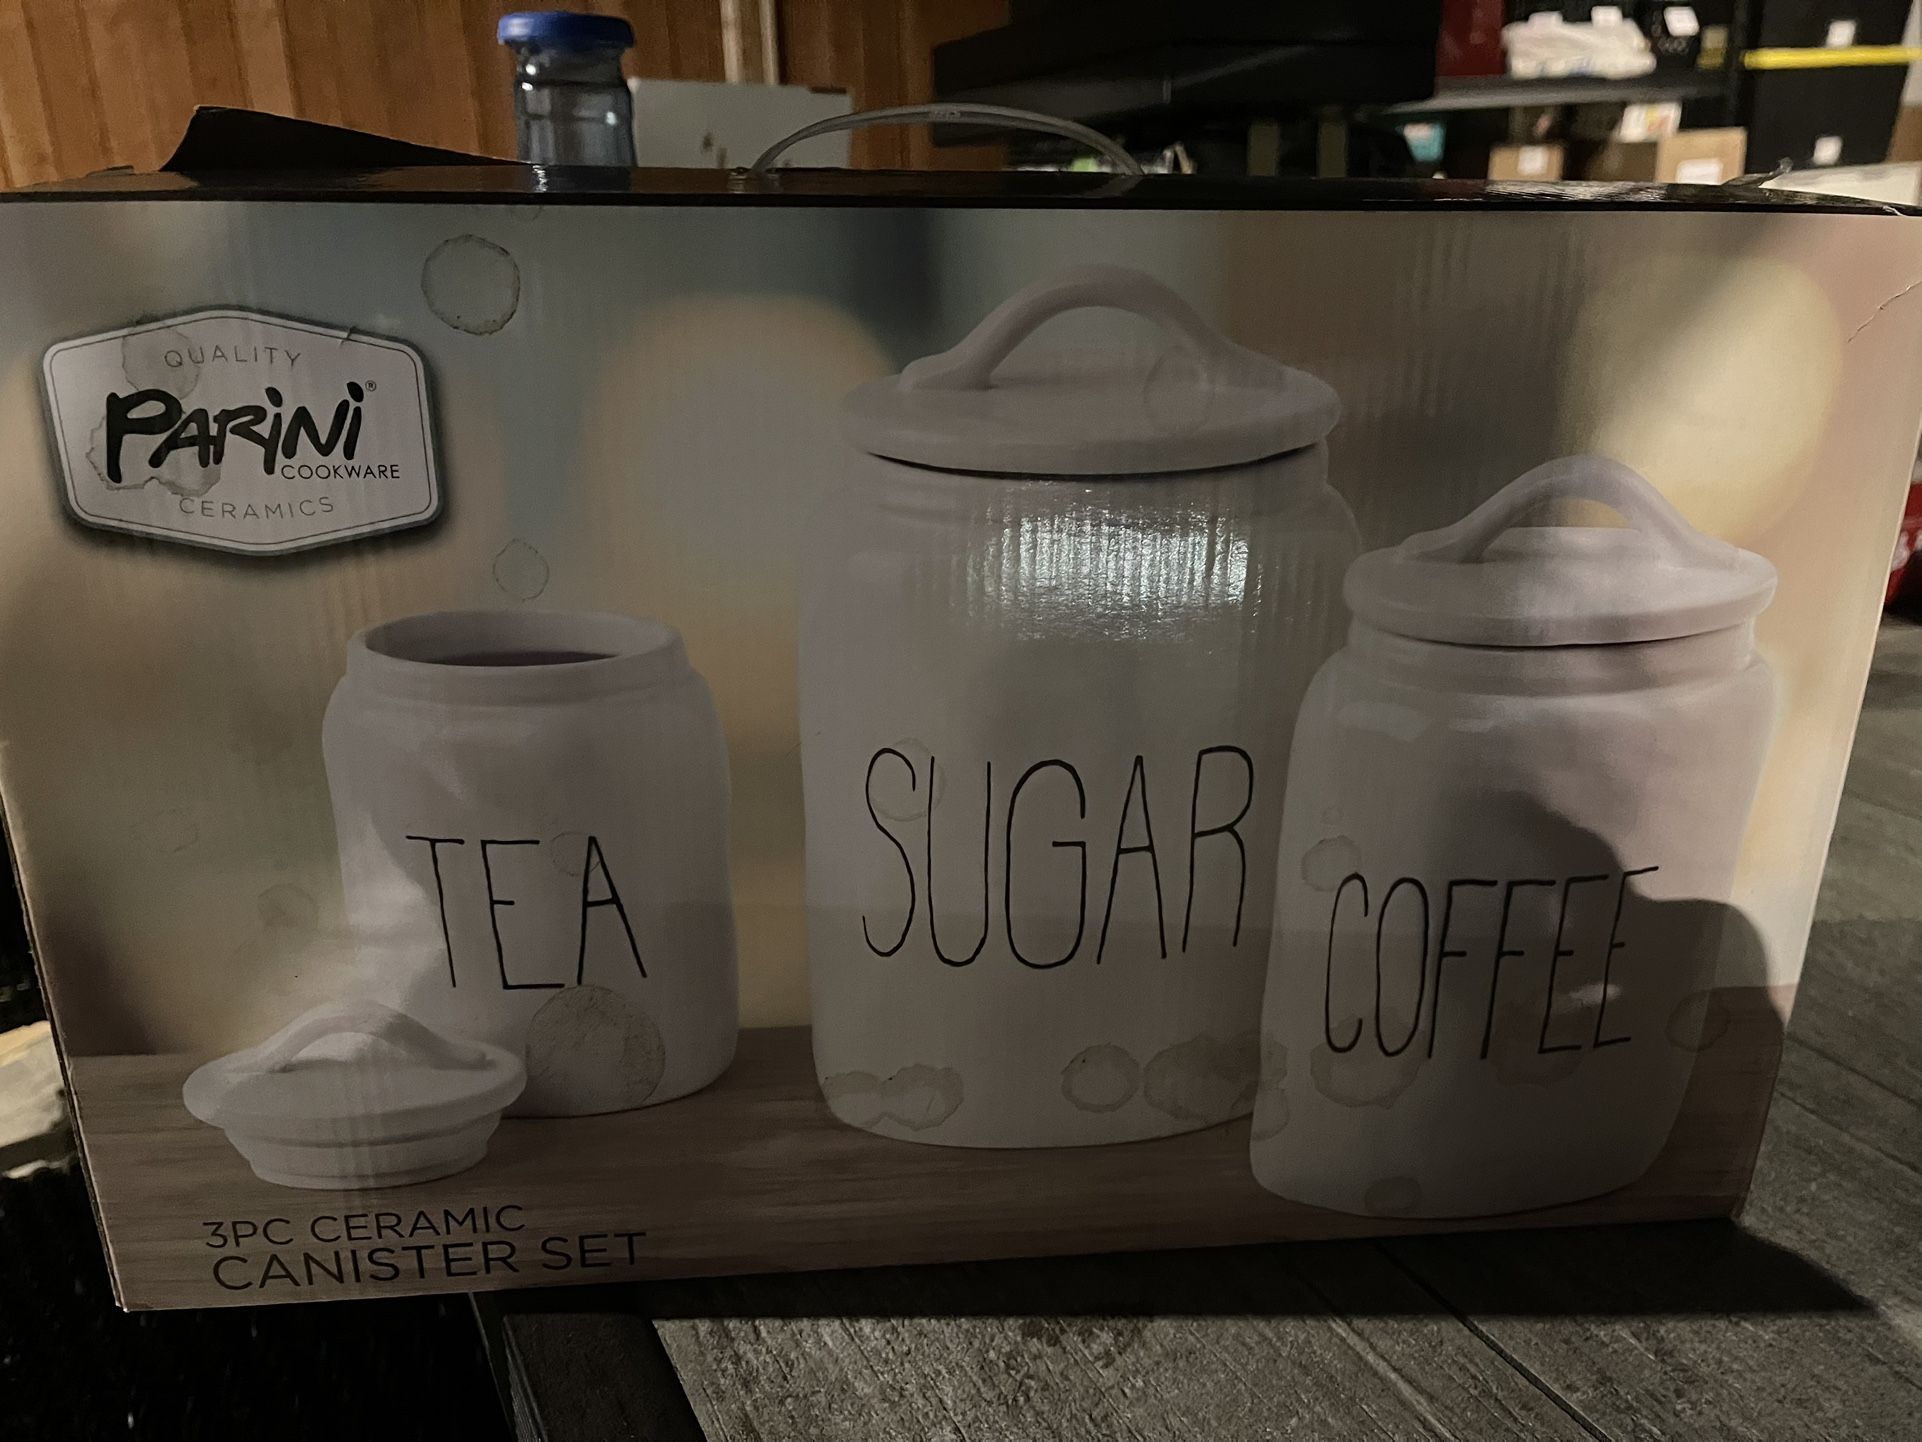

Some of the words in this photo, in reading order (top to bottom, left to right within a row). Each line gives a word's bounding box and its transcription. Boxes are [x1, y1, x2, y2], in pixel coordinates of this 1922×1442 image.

[164, 344, 301, 368] QUALITY
[281, 464, 400, 479] COOKWARE
[179, 496, 334, 519] CERAMICS
[862, 745, 1254, 969] SUGAR
[406, 835, 647, 989] TEA
[1325, 866, 1659, 1059] COFFEE
[203, 1218, 293, 1248] 3PC
[311, 1205, 525, 1242] CERAMIC
[213, 1241, 519, 1290] CANISTER
[541, 1232, 646, 1270] SET
